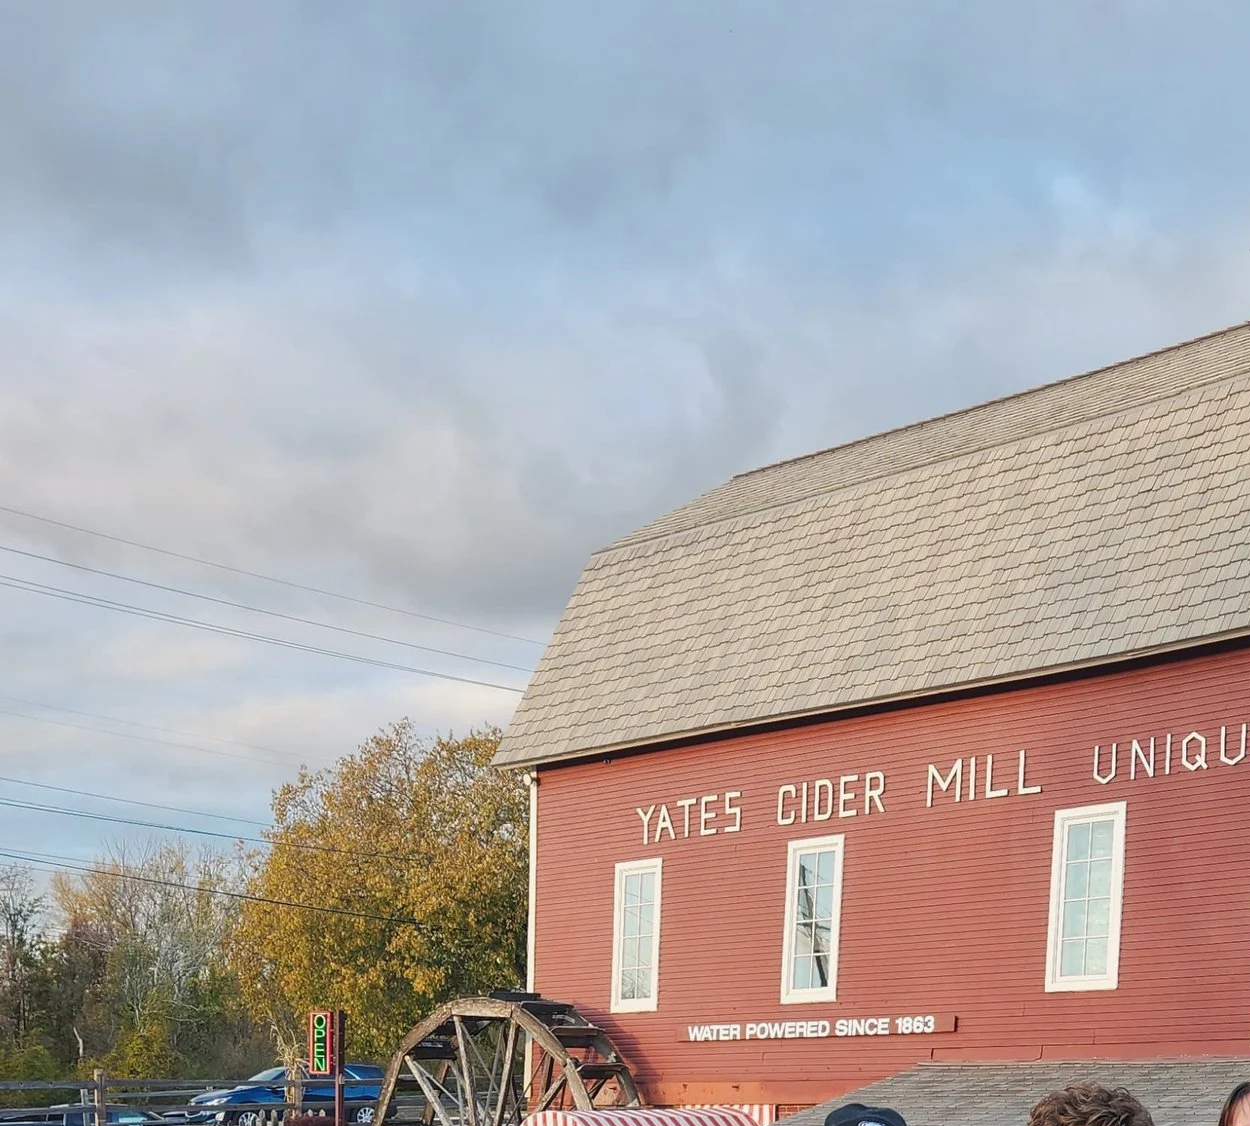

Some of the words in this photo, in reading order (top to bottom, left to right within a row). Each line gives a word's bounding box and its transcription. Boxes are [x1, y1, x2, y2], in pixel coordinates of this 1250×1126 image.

[636, 791, 742, 845] YATES
[777, 771, 886, 826] CIDER
[926, 749, 1042, 808] MILL
[314, 1014, 326, 1072] OPEN
[688, 1024, 741, 1043] WATER
[745, 1021, 831, 1040] POWERED
[835, 1018, 891, 1037] SINCE
[895, 1015, 936, 1034] 1863
